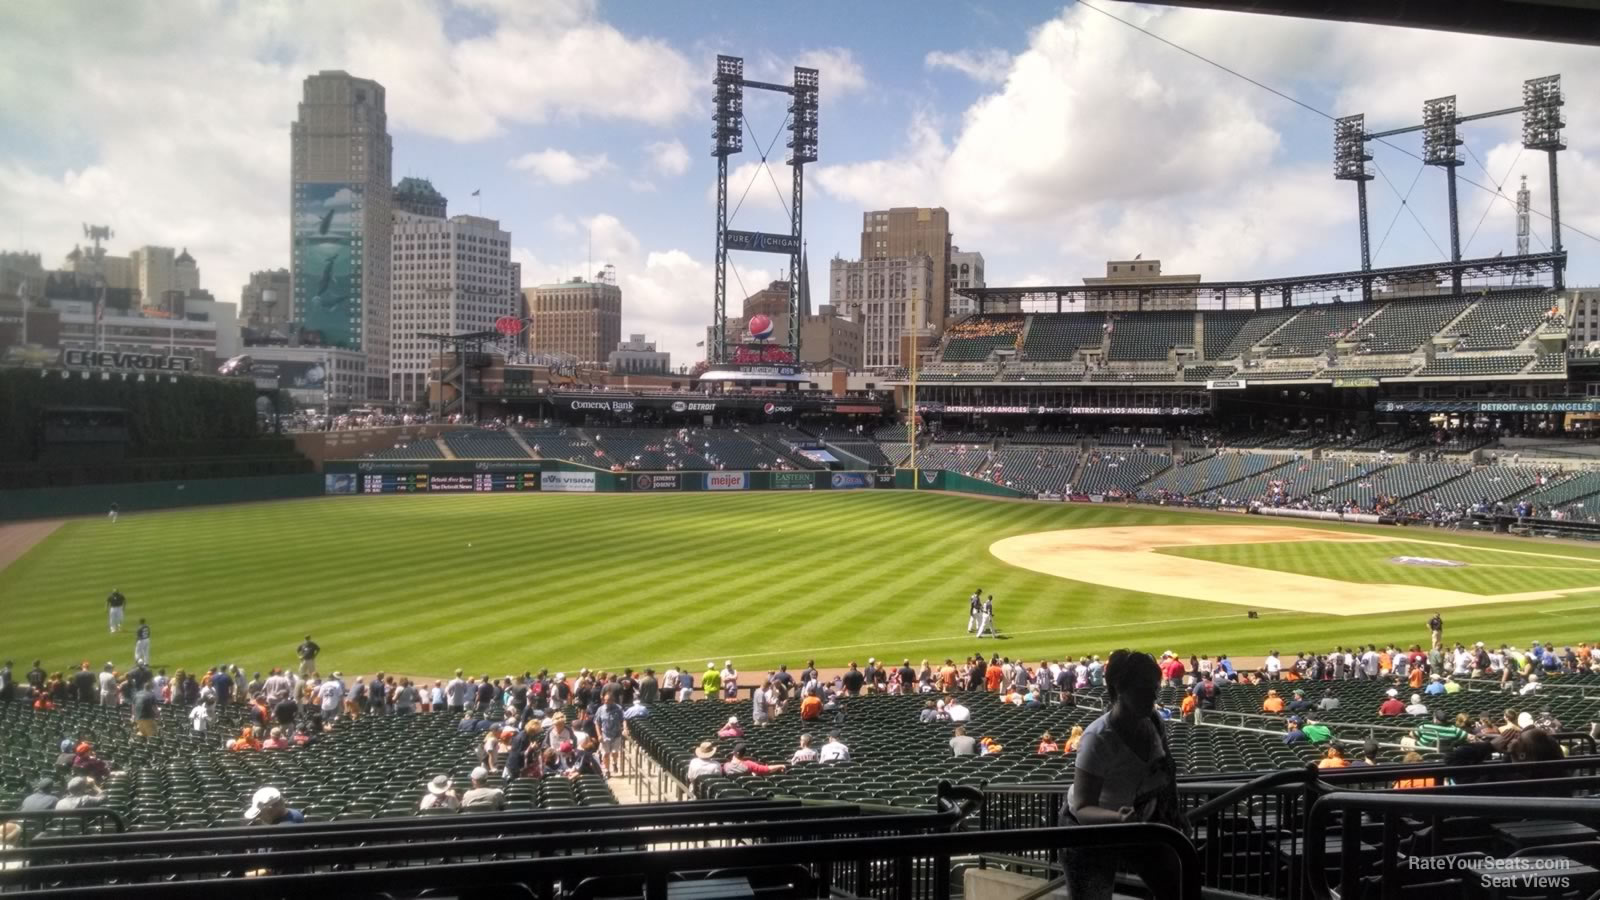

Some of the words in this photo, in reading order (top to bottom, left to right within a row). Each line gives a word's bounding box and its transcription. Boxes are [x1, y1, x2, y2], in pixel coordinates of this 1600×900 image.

[728, 234, 749, 243] PURE
[750, 231, 800, 248] MICHIGAN
[64, 350, 195, 371] CHEVROLET
[40, 370, 178, 383] FOUNTAIN
[612, 401, 634, 410] Bank
[712, 475, 741, 487] meijer
